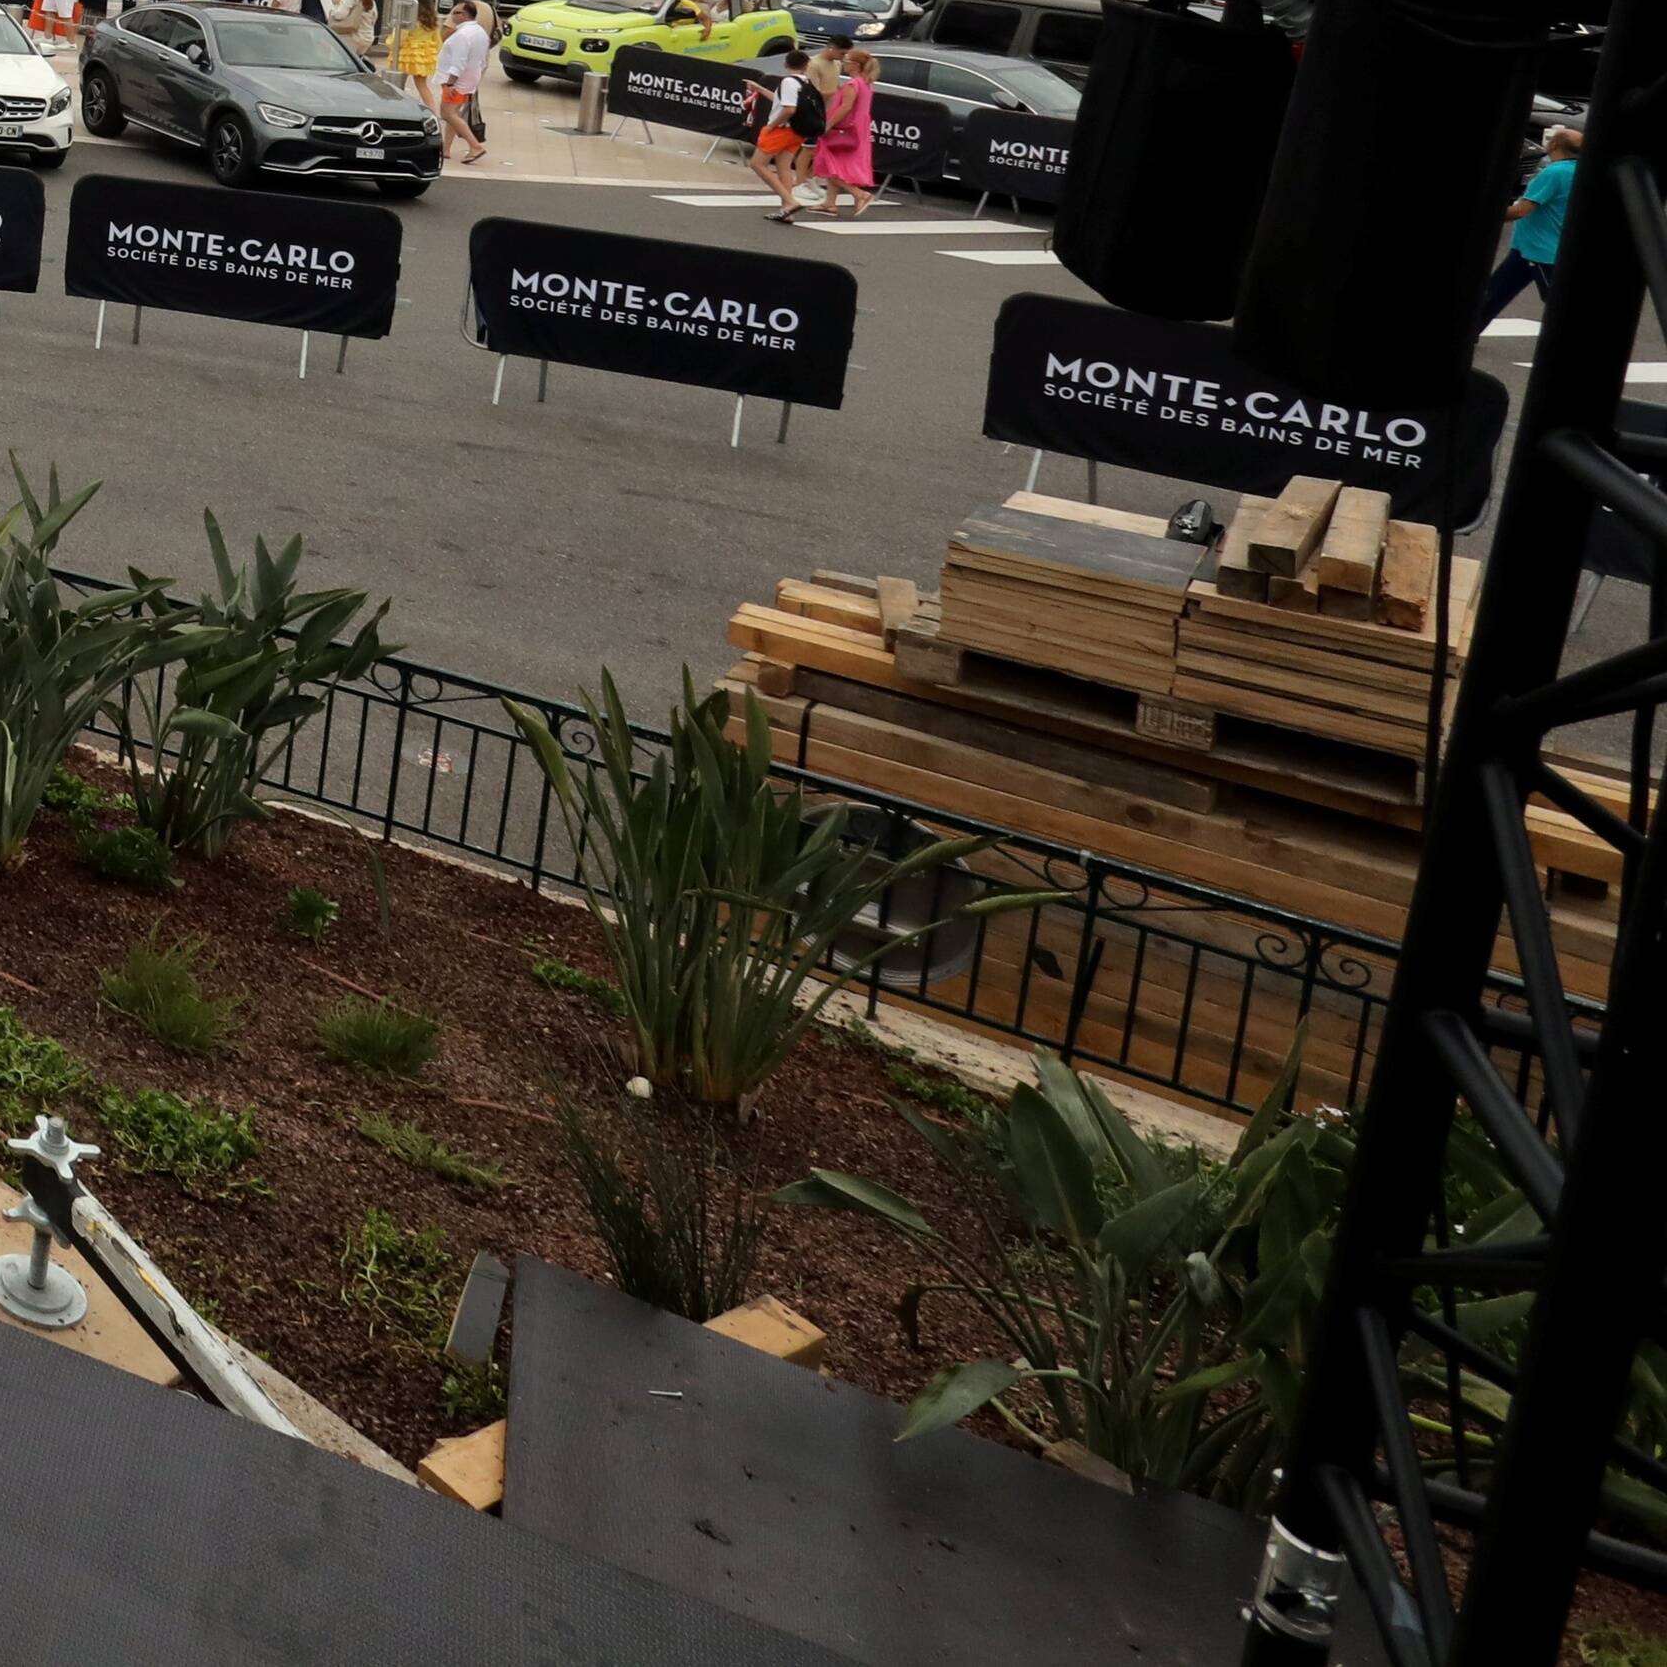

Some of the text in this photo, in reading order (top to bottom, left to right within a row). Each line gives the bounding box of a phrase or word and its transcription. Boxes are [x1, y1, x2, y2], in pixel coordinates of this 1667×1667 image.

[879, 136, 920, 151] DE MER
[988, 155, 1041, 171] SOCIÉTÉ
[107, 246, 353, 290] SOCIÉTÉ DES BAINS DE MER
[509, 295, 796, 351] SOCIÉTÉ DES BAINS DE MER
[1044, 383, 1421, 469] SOCIÉTÉ DES BAINS DE MER
